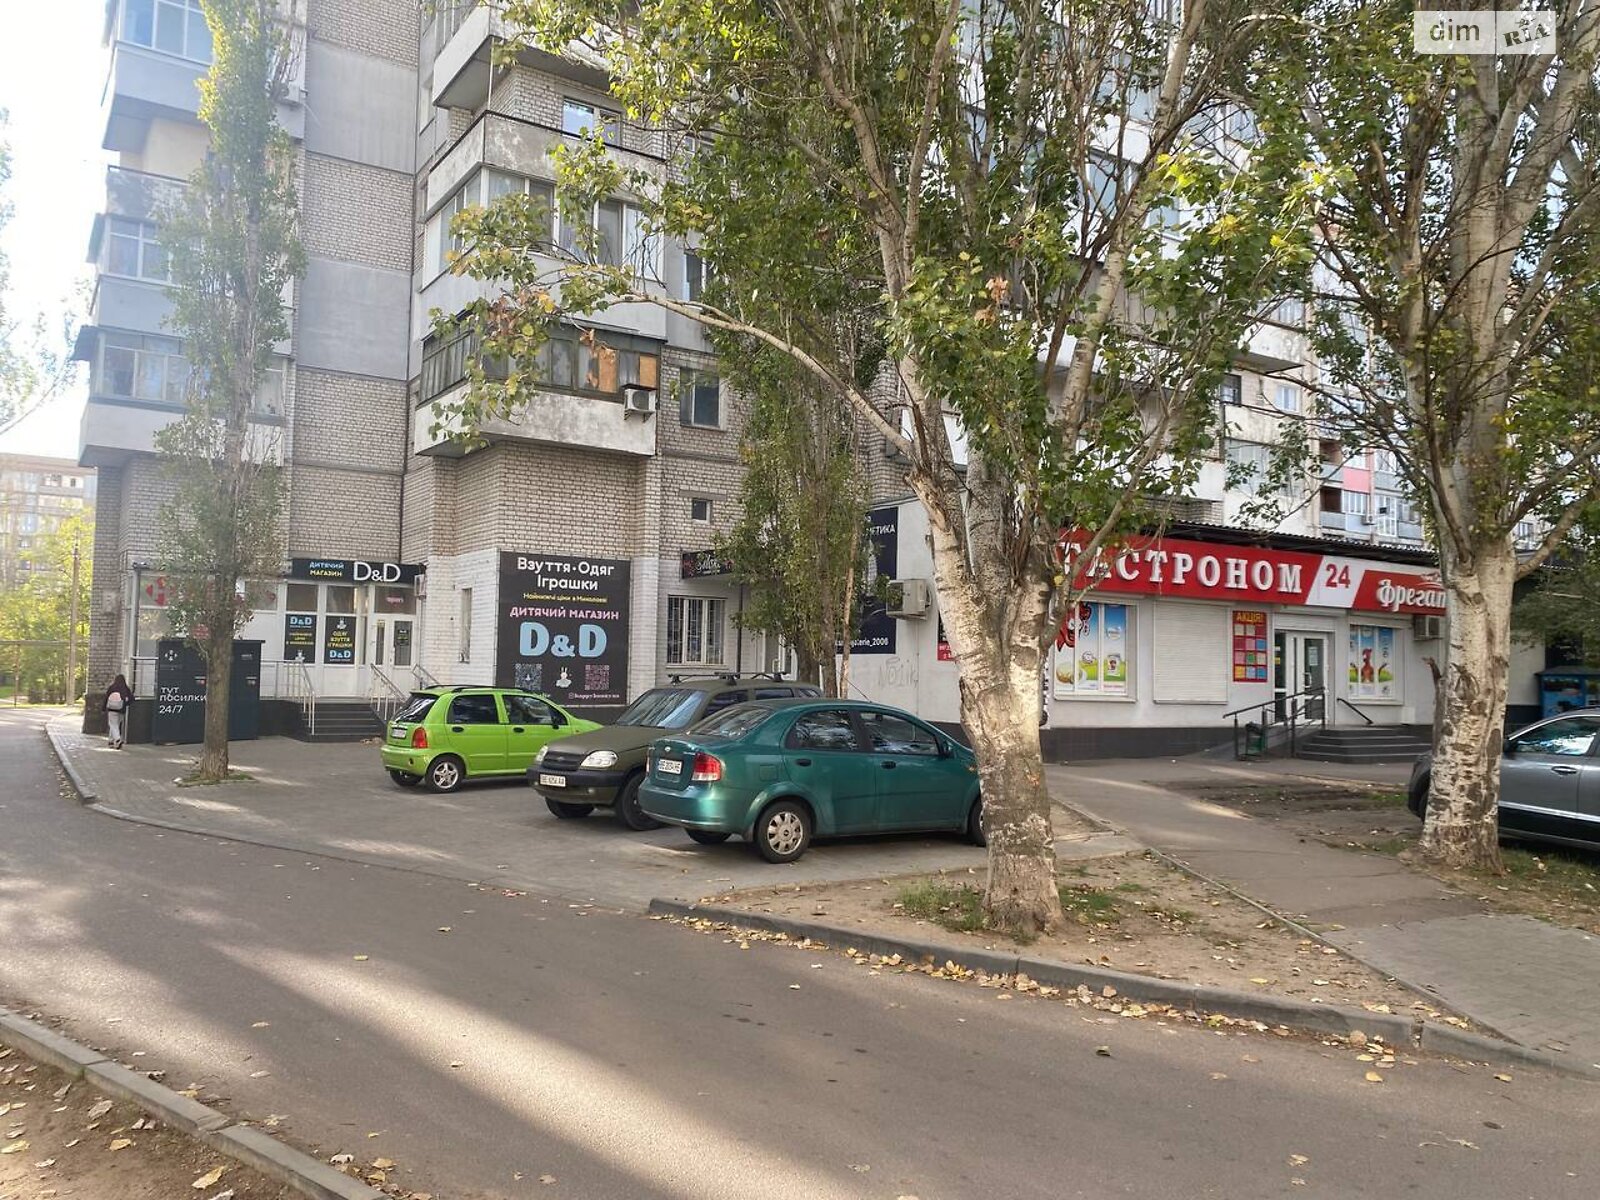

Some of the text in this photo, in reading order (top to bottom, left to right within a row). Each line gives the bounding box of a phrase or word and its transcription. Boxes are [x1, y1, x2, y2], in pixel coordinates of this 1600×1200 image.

[353, 561, 401, 582] D&D
[1325, 563, 1351, 588] 24
[537, 574, 598, 590] Іграшки
[509, 606, 619, 620] ДИТЯЧИЙ МАГАЗИН
[519, 621, 607, 658] D&D
[159, 704, 183, 714] 24/7
